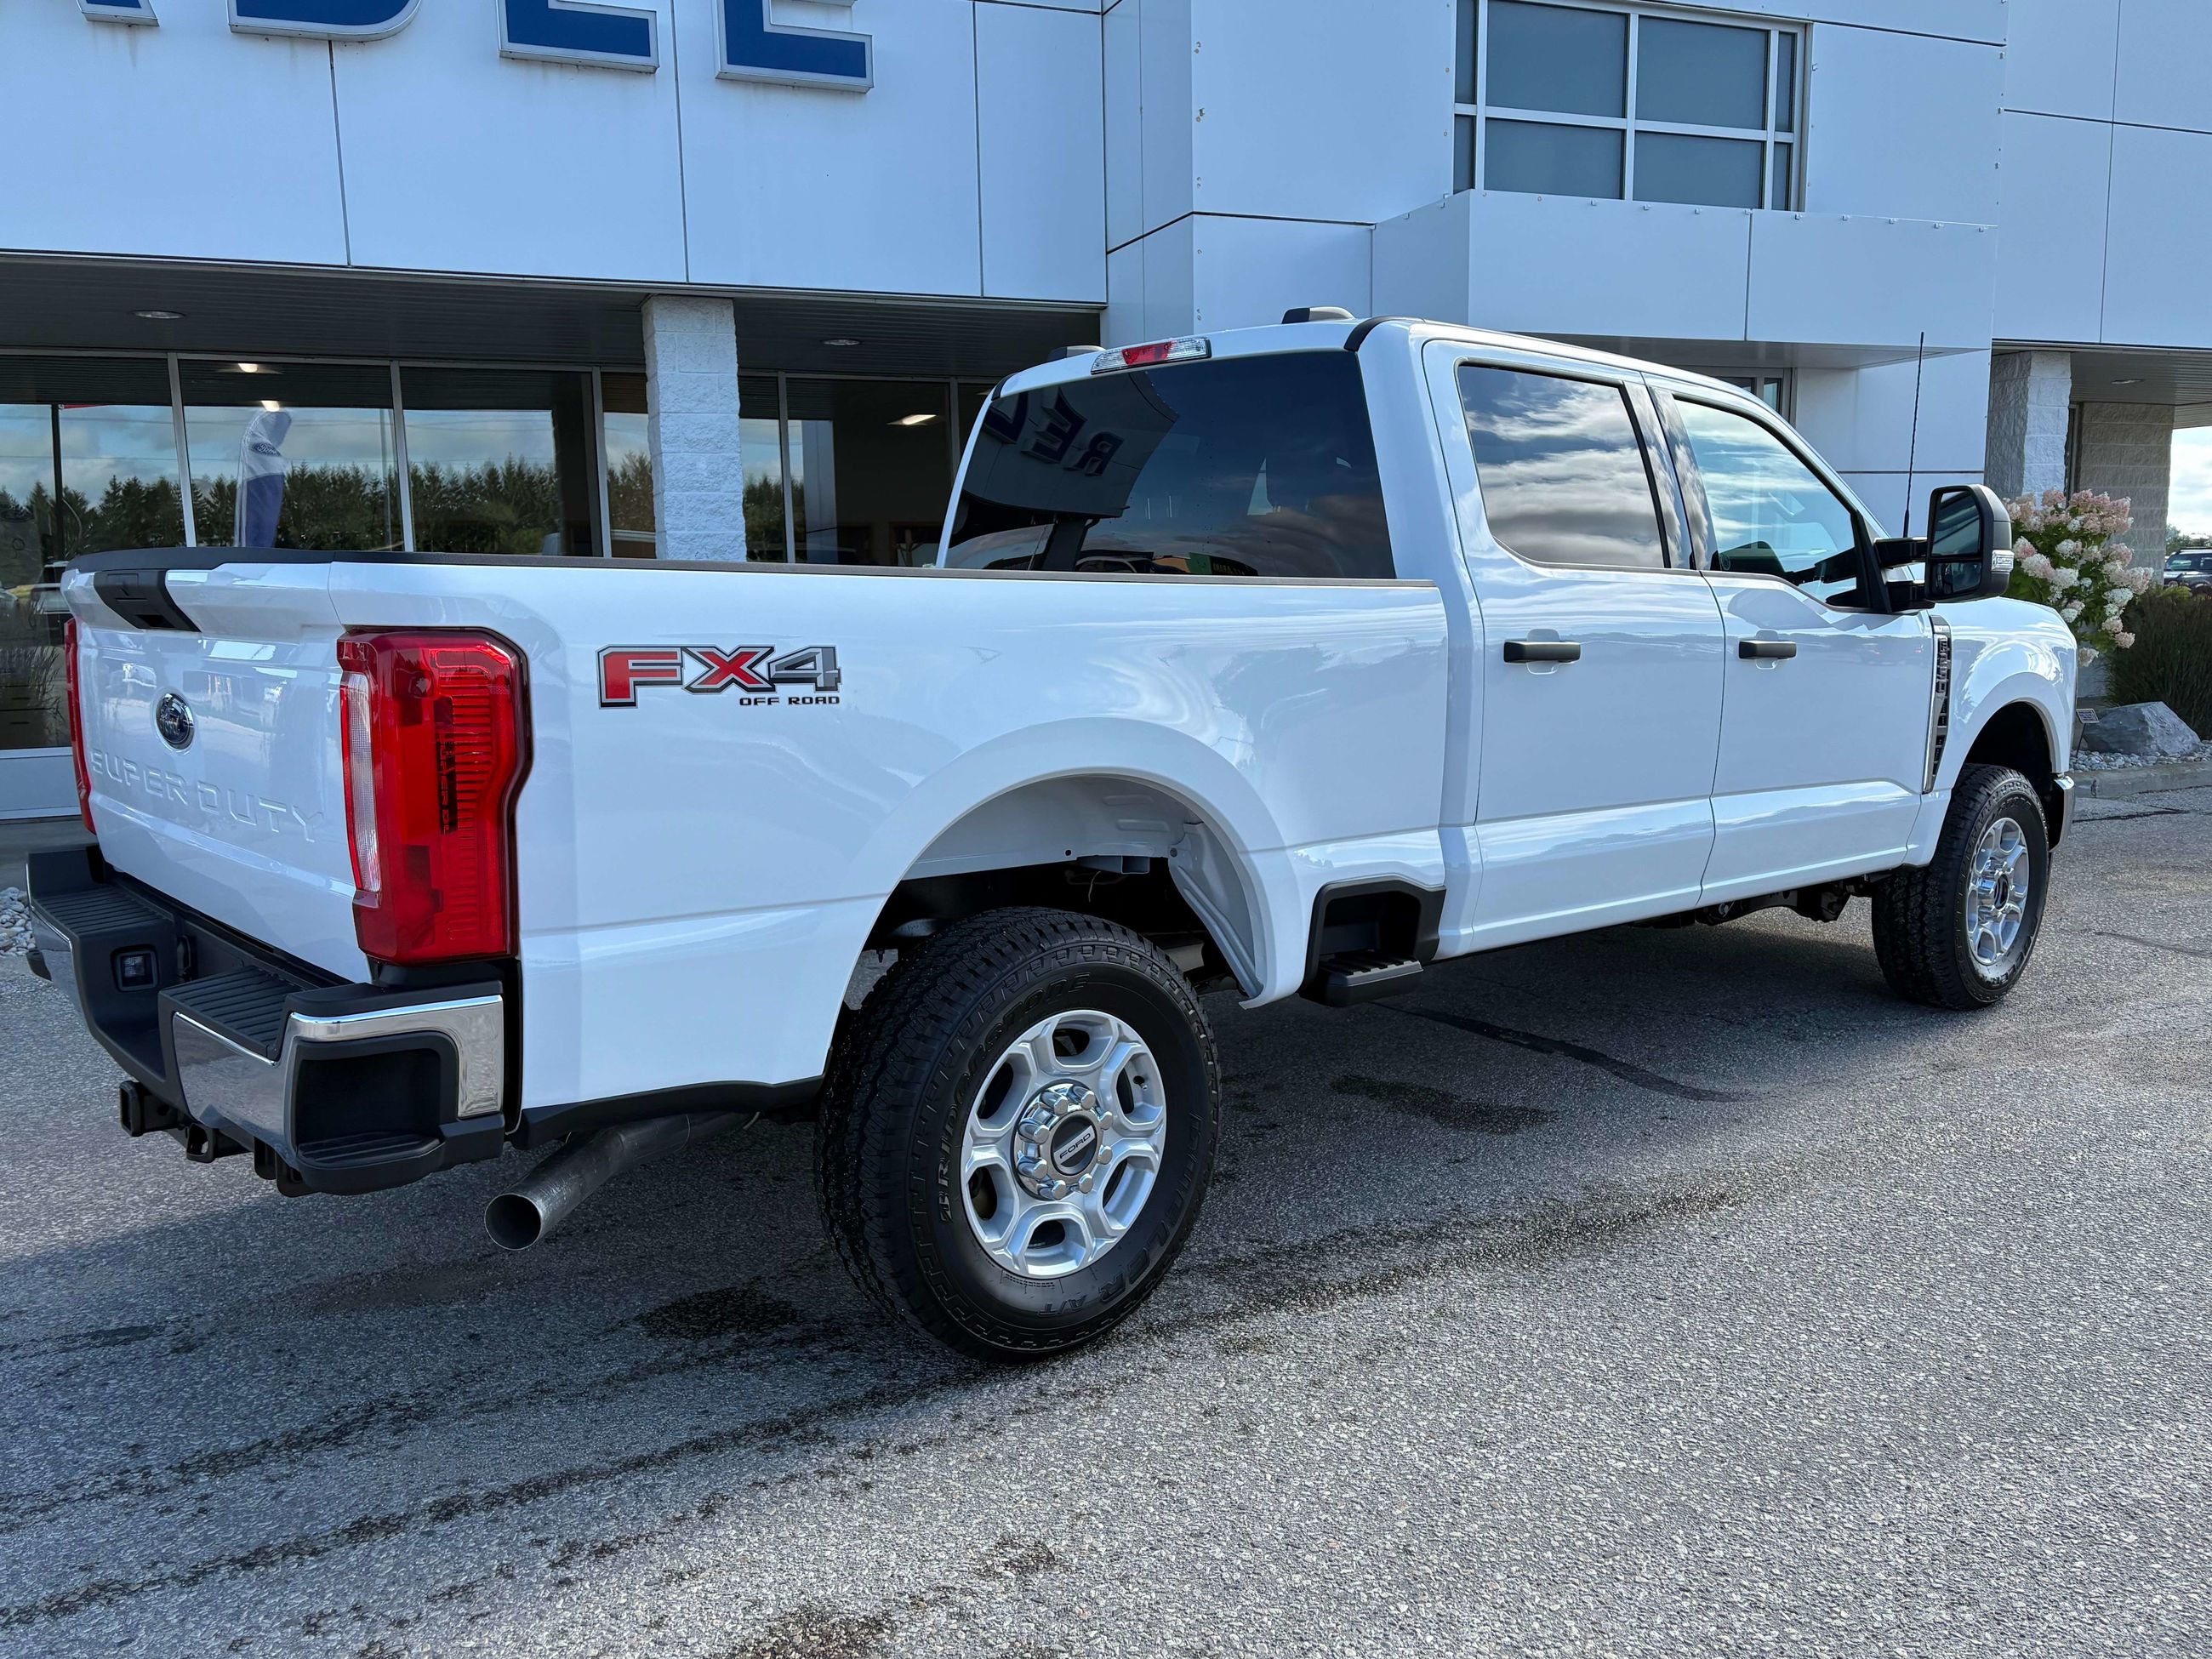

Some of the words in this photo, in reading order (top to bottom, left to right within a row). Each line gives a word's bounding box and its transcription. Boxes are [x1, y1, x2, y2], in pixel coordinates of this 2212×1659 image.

[596, 644, 841, 710] FX4
[738, 696, 780, 706] OFF
[788, 695, 841, 705] ROAD
[90, 748, 188, 806] SUPER
[197, 780, 323, 843] DUTY
[1059, 1132, 1092, 1160] FORD
